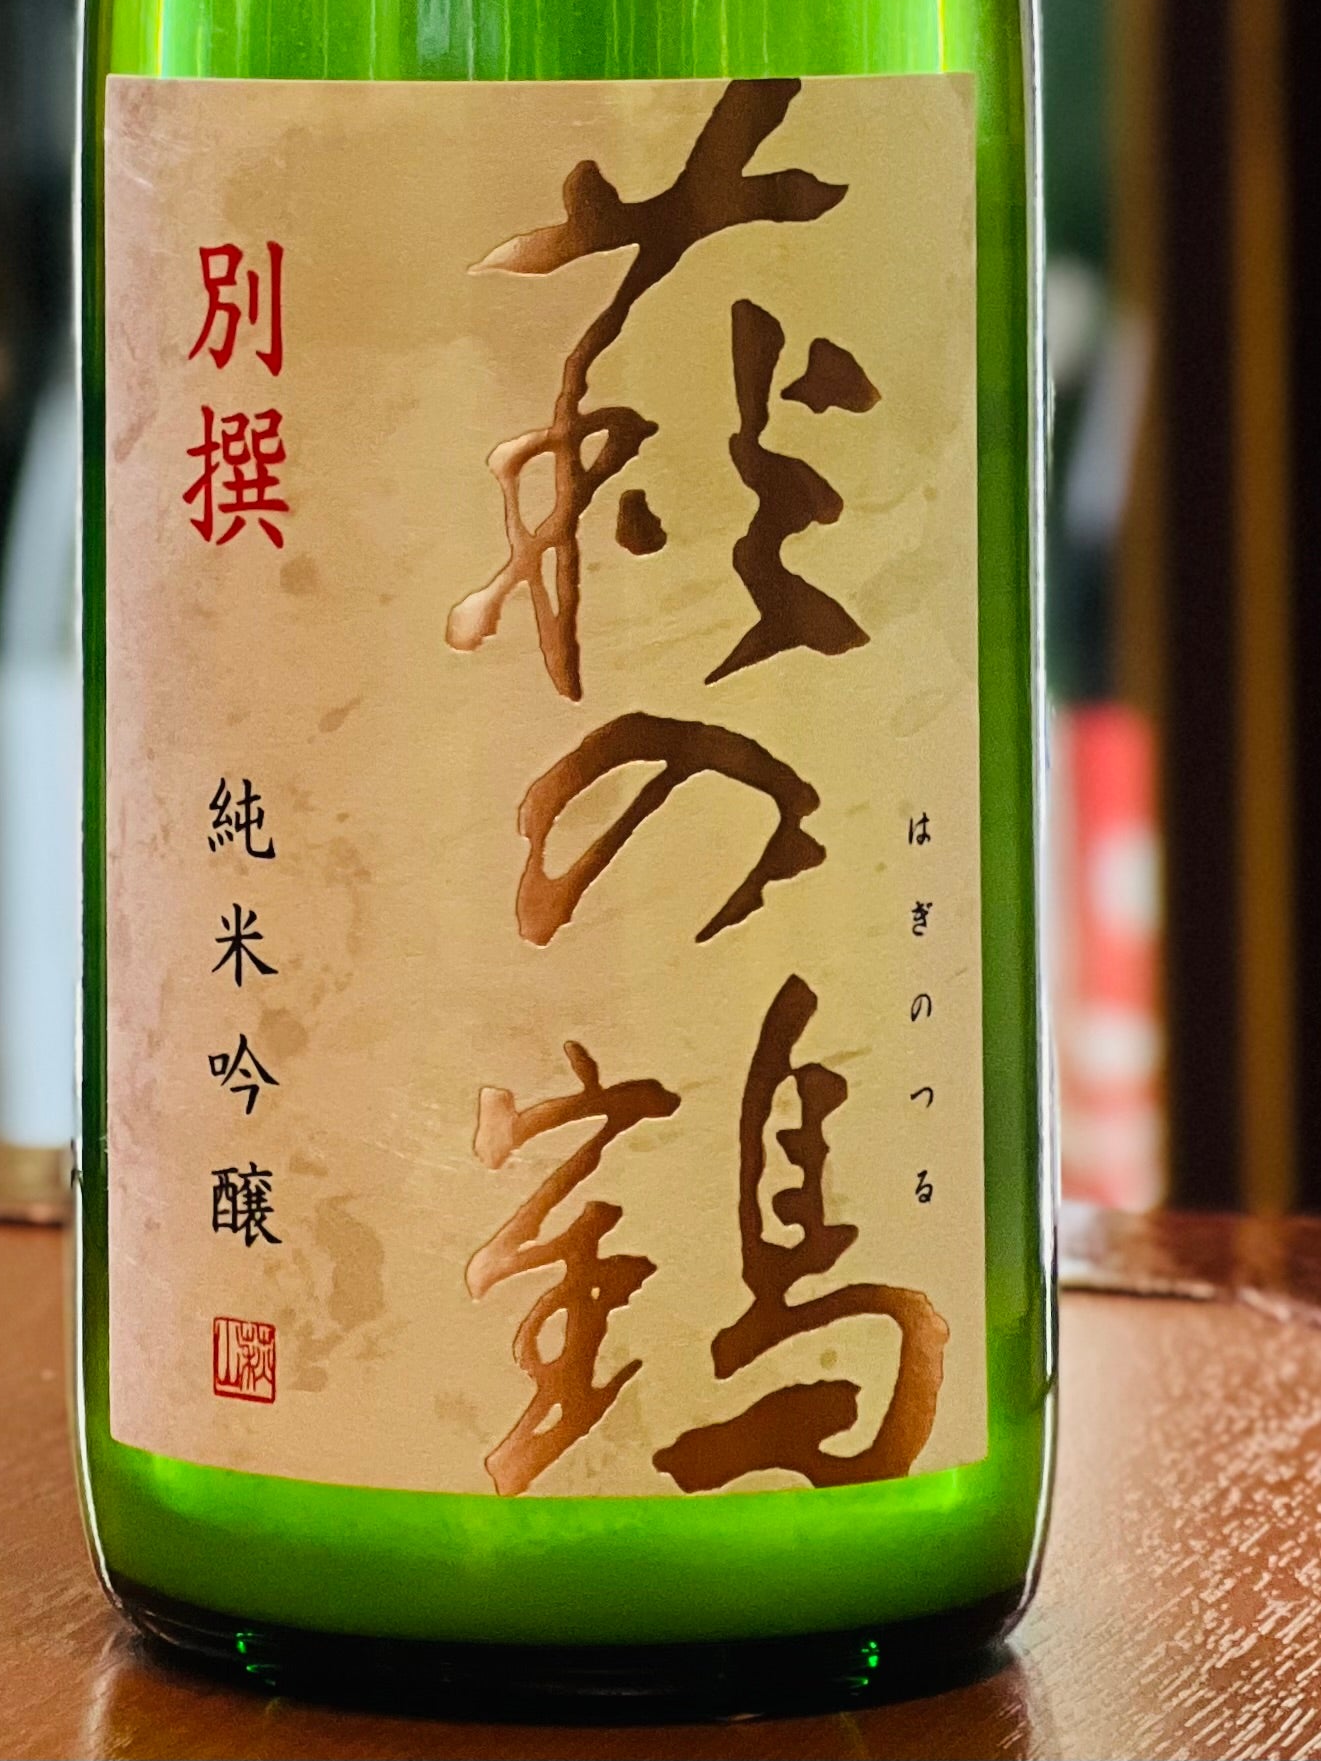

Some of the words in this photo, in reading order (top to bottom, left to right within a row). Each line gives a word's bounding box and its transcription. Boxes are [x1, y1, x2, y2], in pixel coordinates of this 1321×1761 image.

[183, 240, 290, 549] 別撰
[445, 79, 949, 1496] 萩の鶴
[908, 813, 934, 1204] はぎのつる
